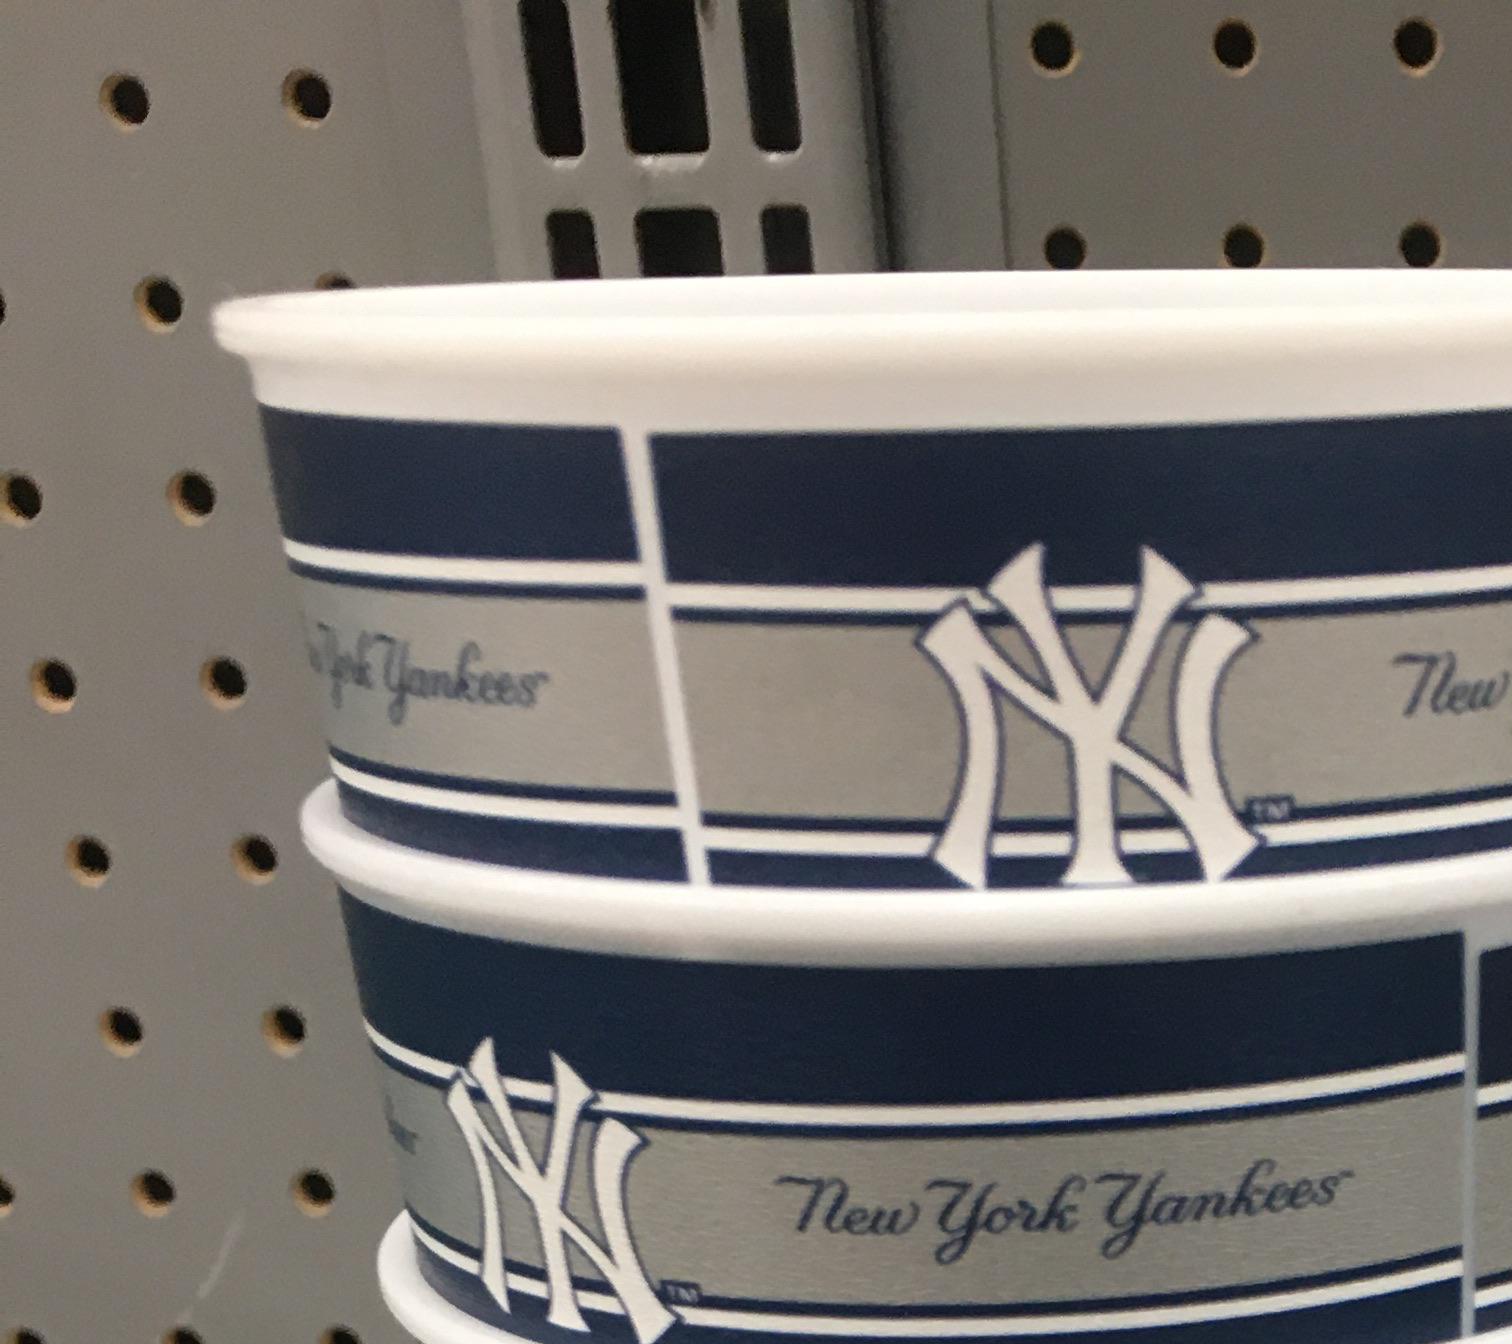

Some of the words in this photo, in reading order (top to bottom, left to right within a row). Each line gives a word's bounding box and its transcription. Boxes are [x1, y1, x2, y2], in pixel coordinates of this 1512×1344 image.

[373, 633, 541, 726] Yankees
[1392, 650, 1511, 718] New
[774, 1175, 919, 1237] New
[923, 1174, 1085, 1266] York
[1093, 1158, 1342, 1260] Yankees
